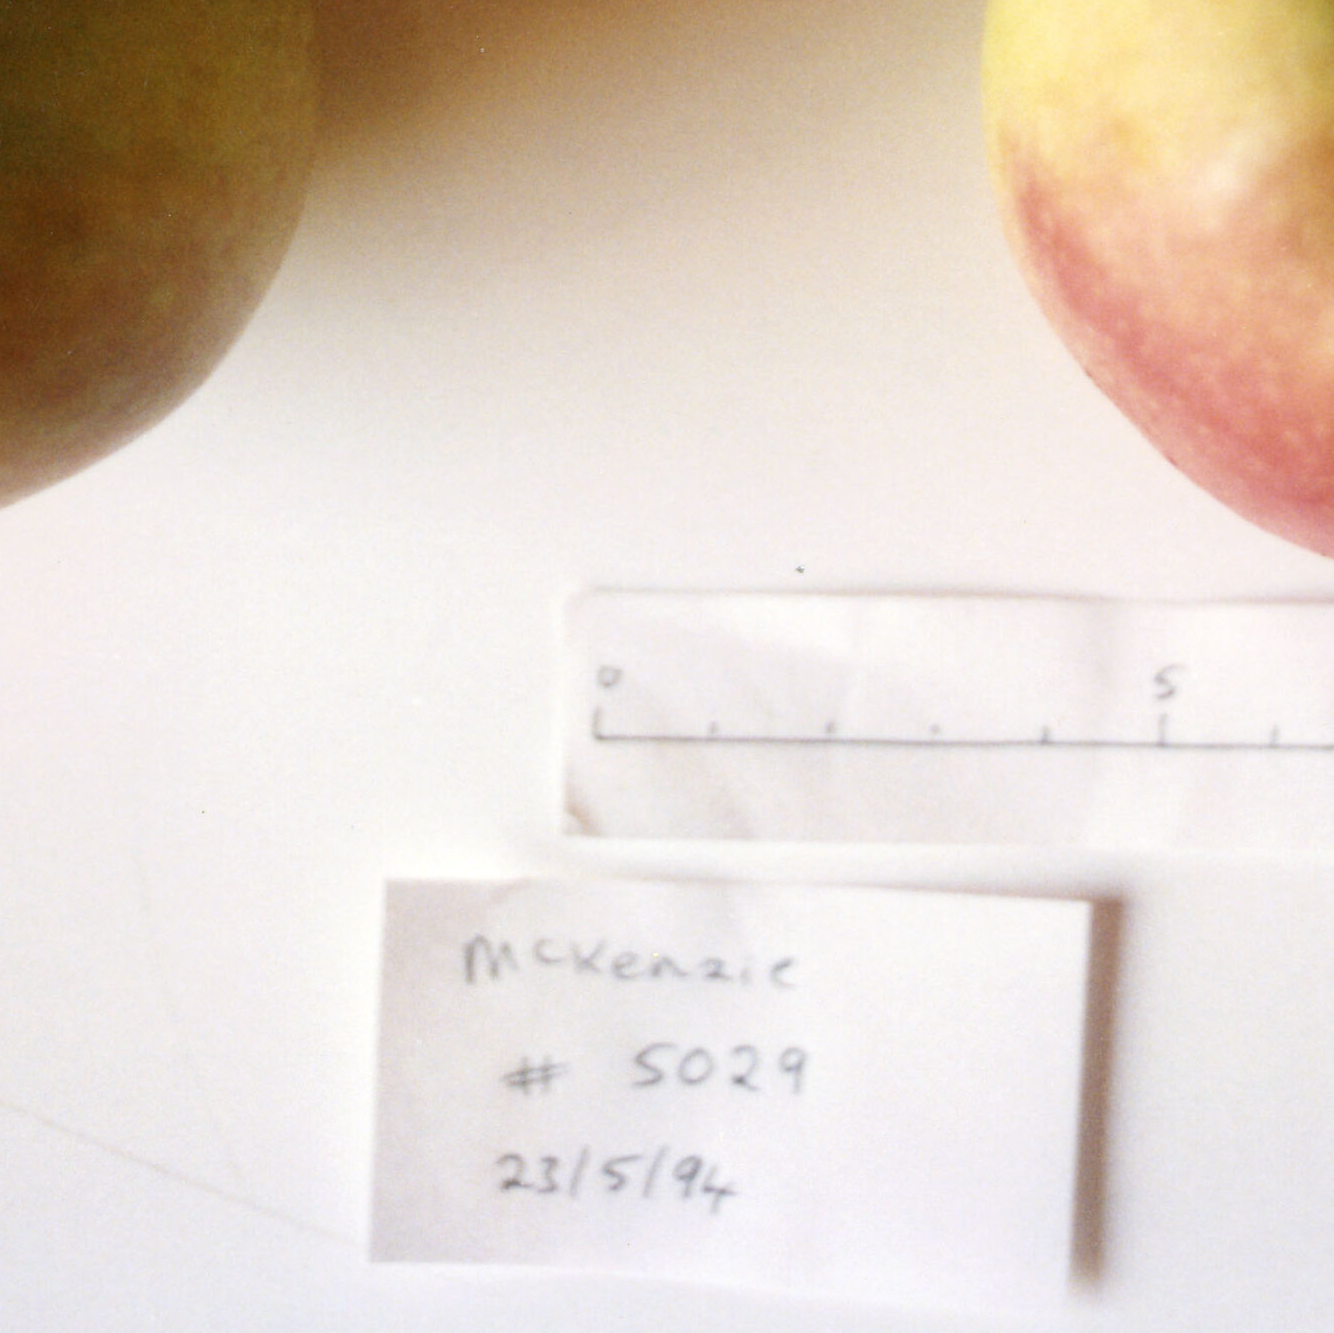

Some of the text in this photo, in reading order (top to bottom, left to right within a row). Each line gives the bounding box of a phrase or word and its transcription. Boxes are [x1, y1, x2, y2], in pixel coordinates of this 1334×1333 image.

[596, 664, 623, 689] 0
[1154, 664, 1185, 700] 5
[501, 1041, 809, 1096] # 5029
[496, 1145, 736, 1213] 23/5/94
